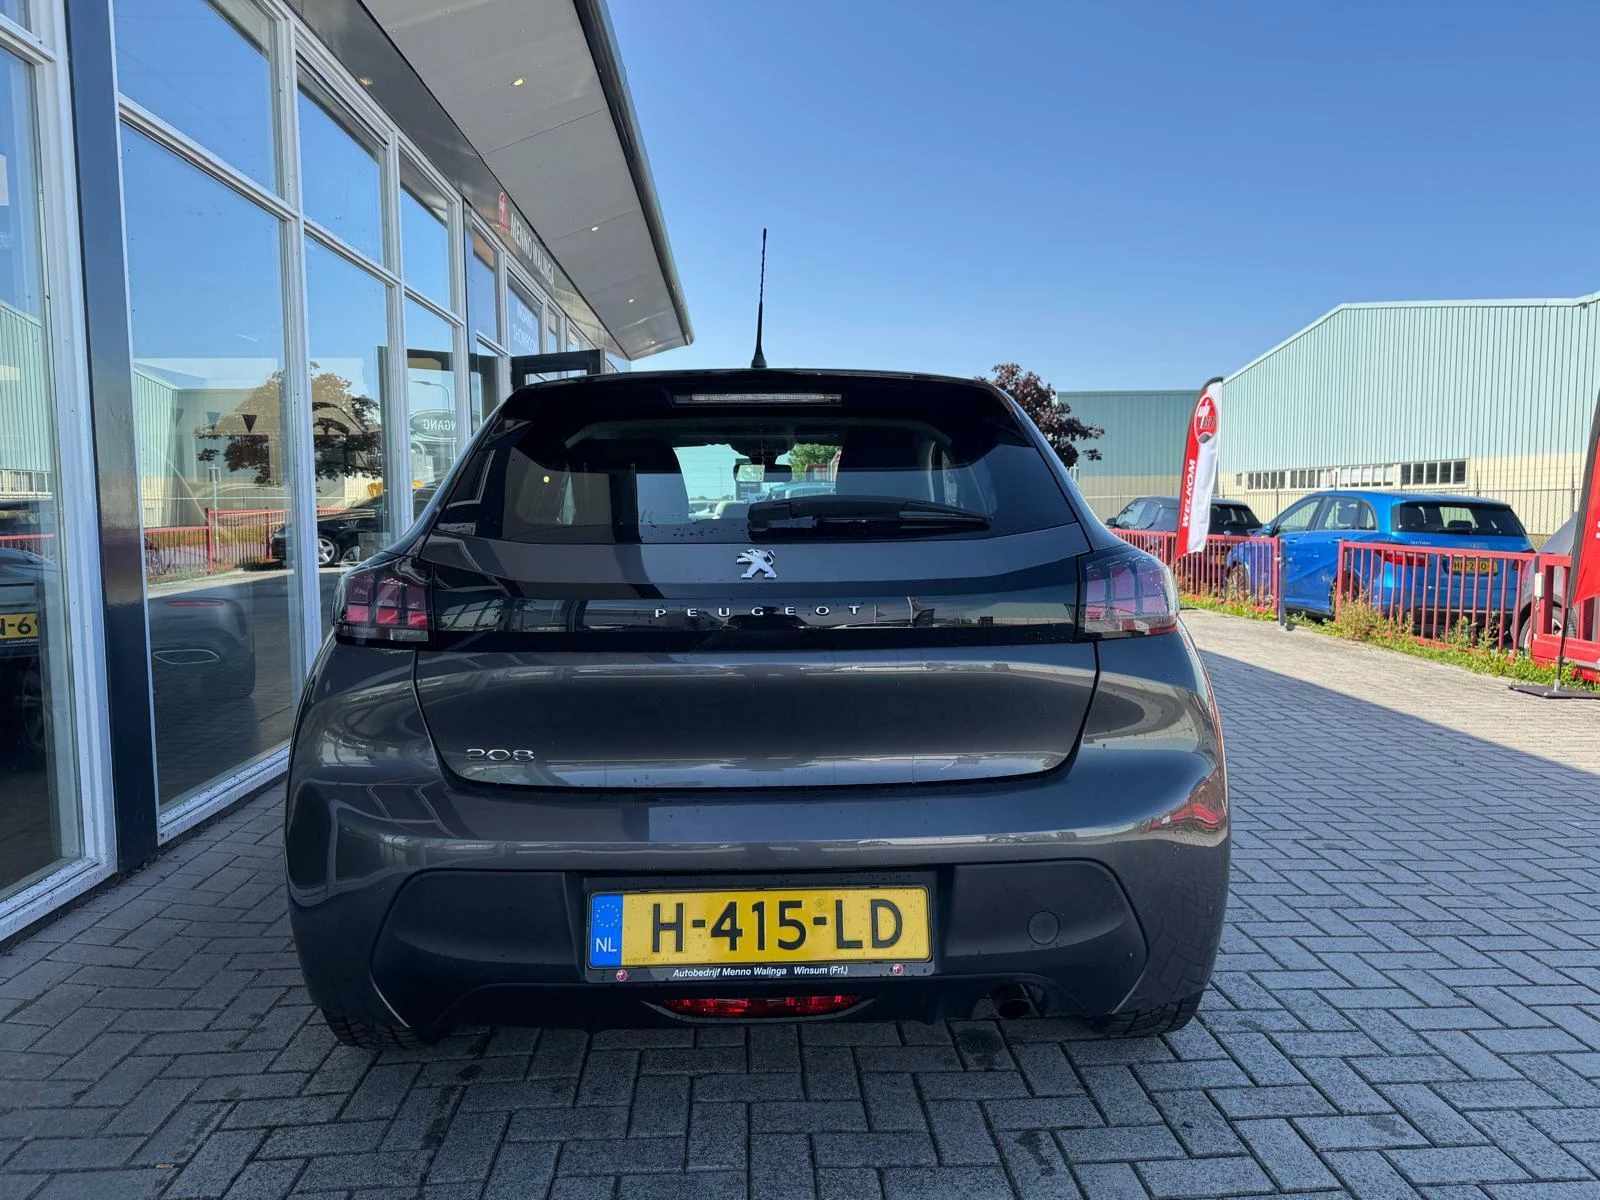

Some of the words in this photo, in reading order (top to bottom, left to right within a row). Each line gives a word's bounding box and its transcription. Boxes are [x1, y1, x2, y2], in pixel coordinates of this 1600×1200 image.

[510, 212, 533, 261] MENNO
[532, 242, 555, 289] WALINGA
[1181, 459, 1197, 528] WELKOM
[654, 604, 861, 618] PEUGEOT
[466, 748, 535, 761] 208
[652, 898, 903, 953] H-415-LD
[595, 937, 618, 953] NL
[672, 968, 721, 978] Autobedrijf
[722, 967, 752, 976] Menno
[753, 967, 787, 978] Walinga
[794, 966, 827, 976] Winsum
